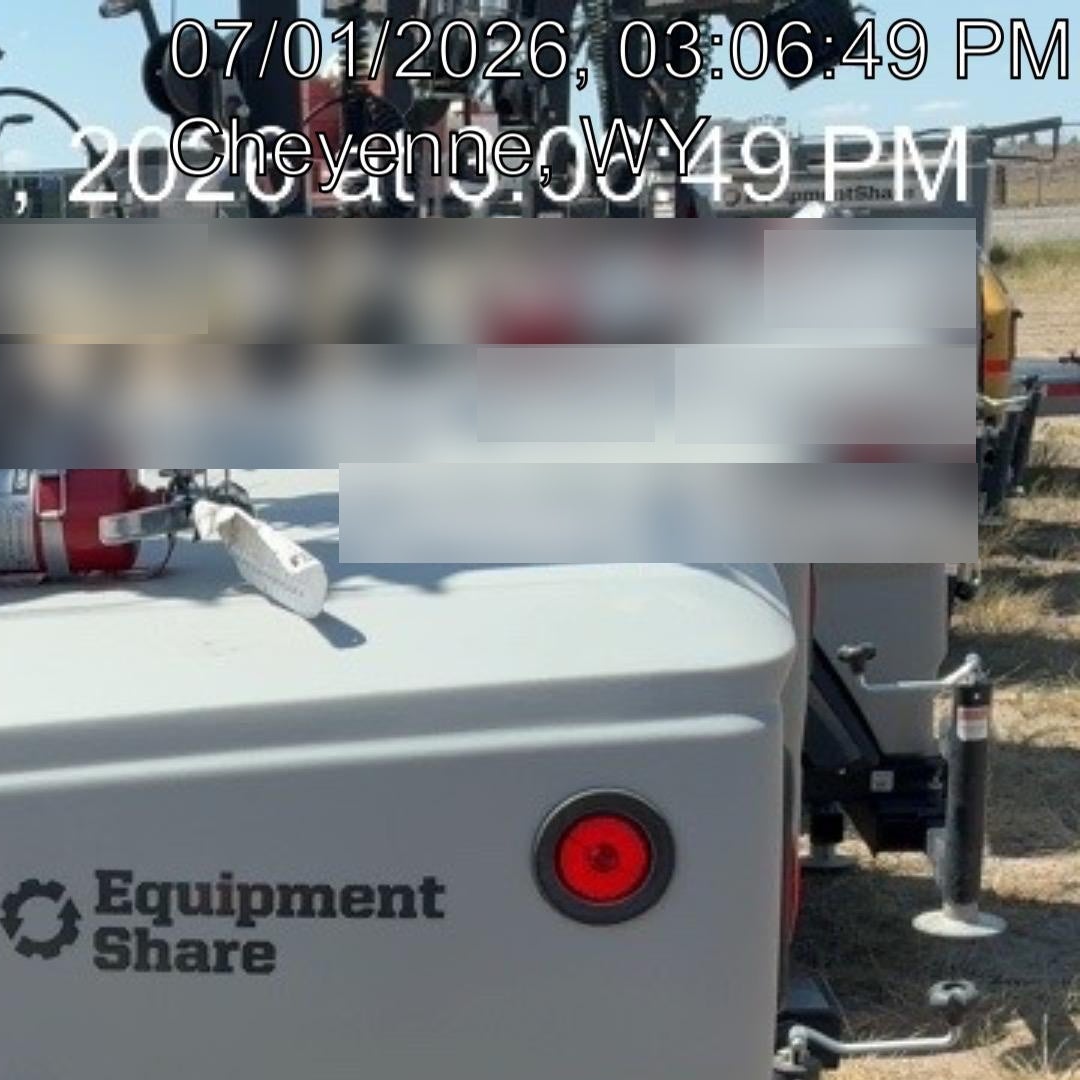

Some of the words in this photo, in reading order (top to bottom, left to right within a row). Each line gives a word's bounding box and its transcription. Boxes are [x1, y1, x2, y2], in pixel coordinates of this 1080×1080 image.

[741, 184, 913, 206] pmntShae
[94, 869, 447, 928] Equipment
[93, 926, 277, 976] Share
